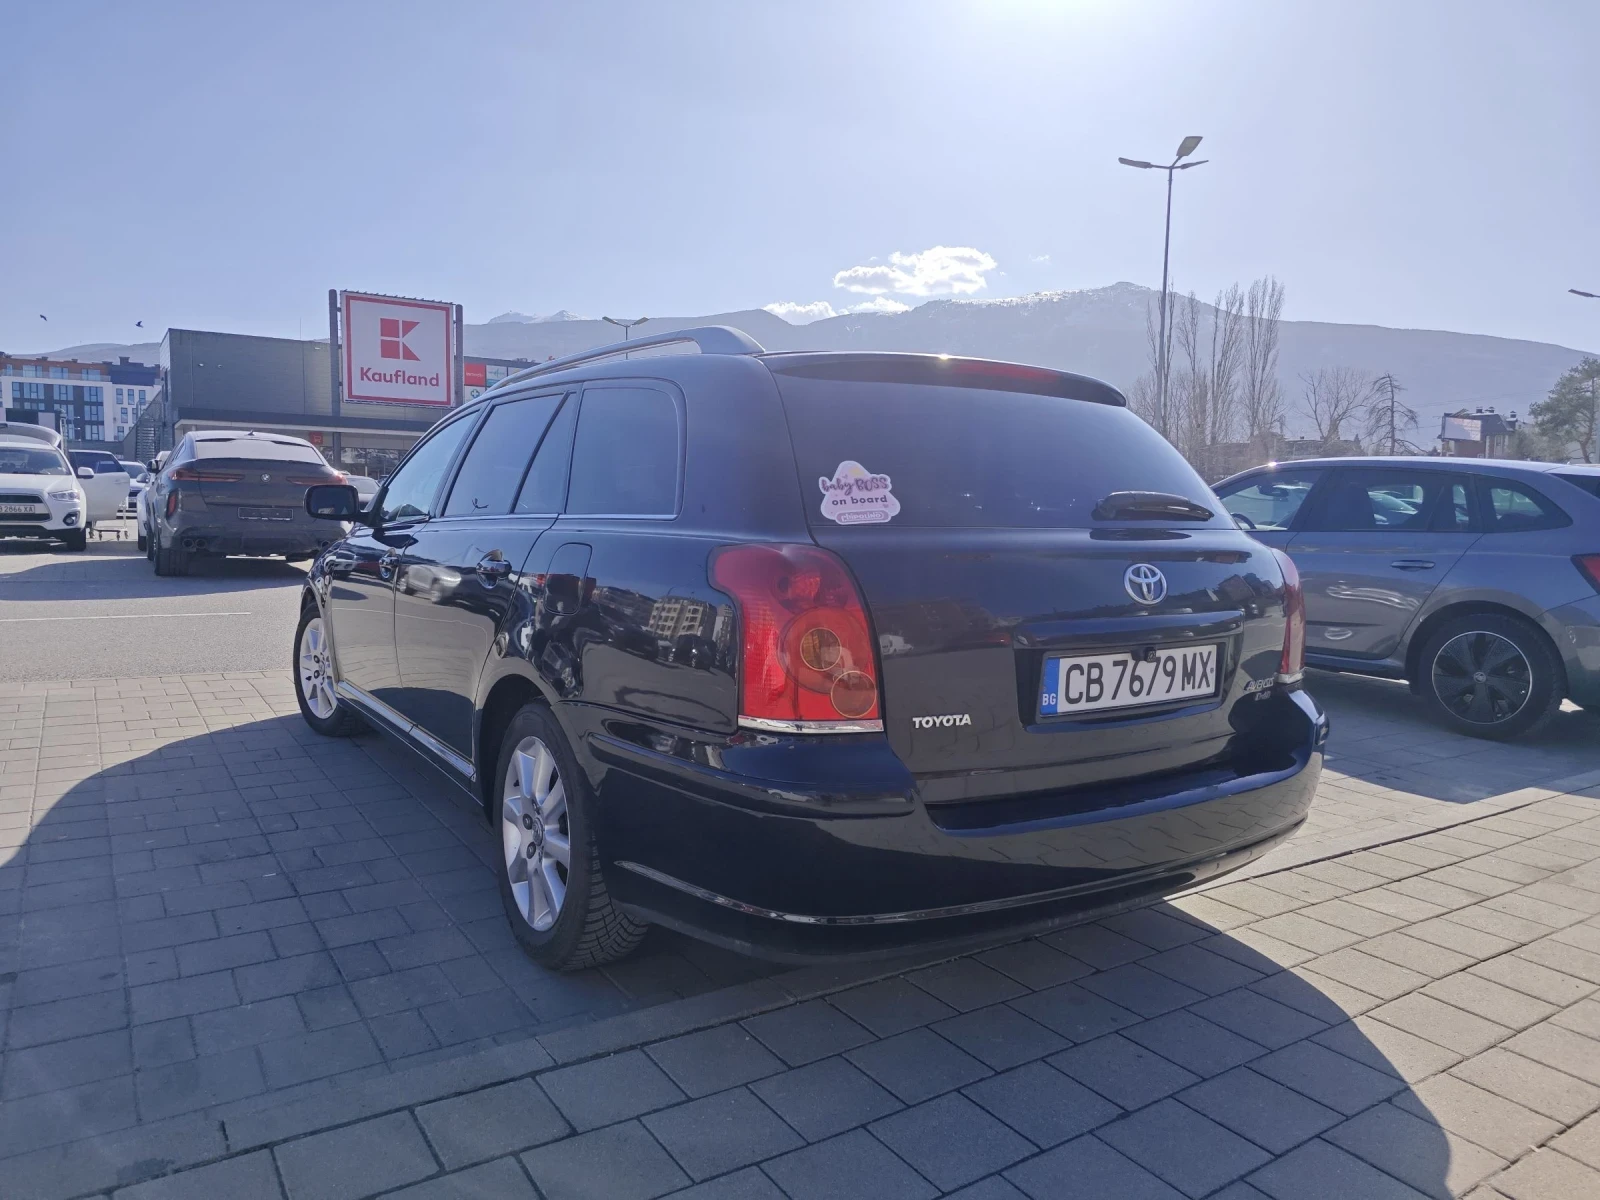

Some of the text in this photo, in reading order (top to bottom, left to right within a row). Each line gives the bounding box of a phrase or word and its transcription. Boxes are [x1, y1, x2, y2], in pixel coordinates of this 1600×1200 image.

[360, 366, 440, 387] Kaufland
[821, 478, 853, 495] baby
[850, 495, 888, 504] board
[1064, 651, 1212, 705] CB 7679 MX
[1042, 693, 1057, 706] BG
[912, 713, 972, 729] TOYOTA
